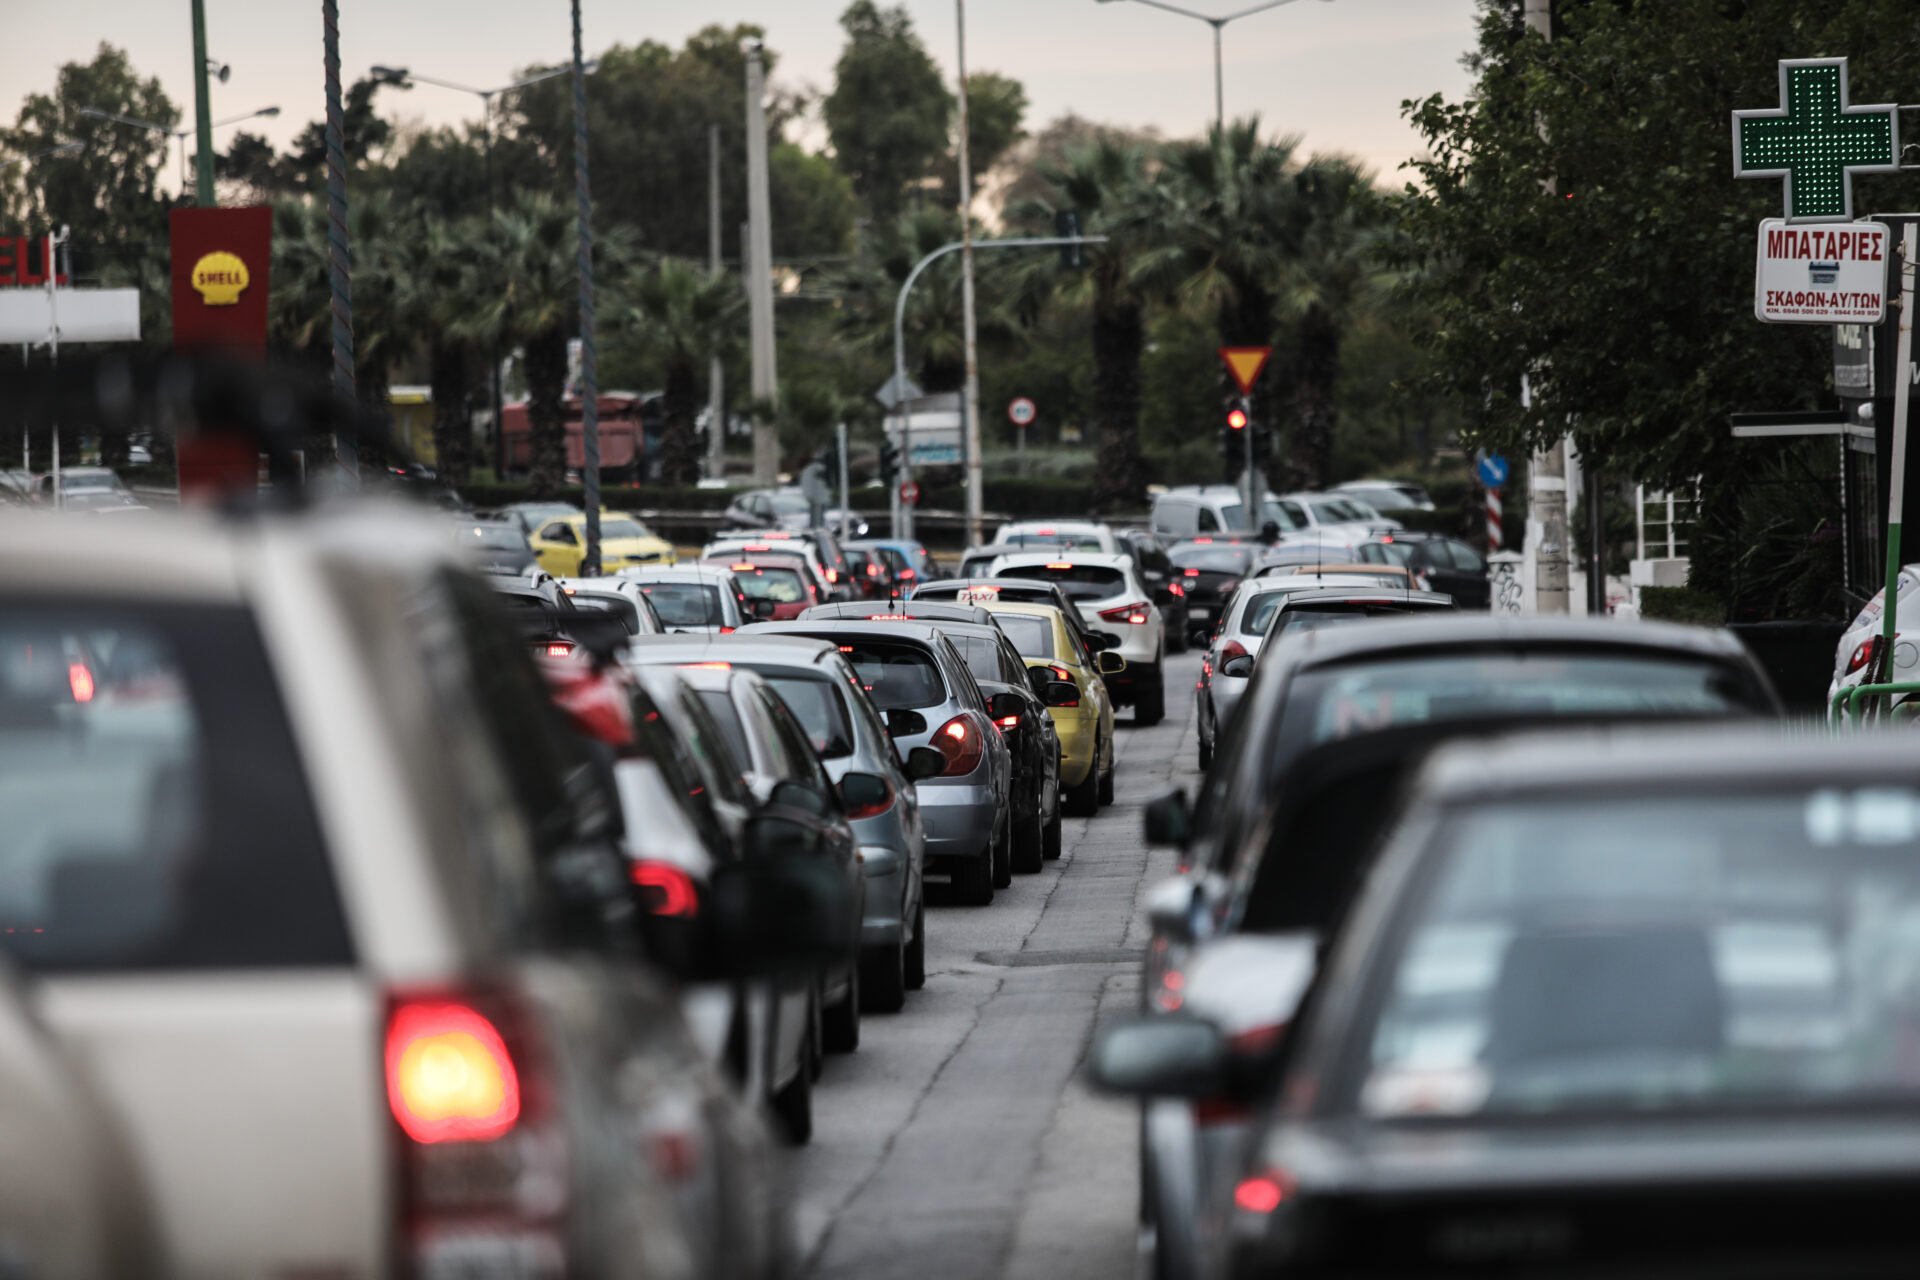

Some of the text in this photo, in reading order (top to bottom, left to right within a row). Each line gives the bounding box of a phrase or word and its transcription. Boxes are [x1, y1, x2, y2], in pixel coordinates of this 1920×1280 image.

[1767, 230, 1882, 261] ΜΠΑΤΑΡΙΕΣ
[198, 272, 242, 285] SHELL
[961, 593, 995, 601] TAXI
